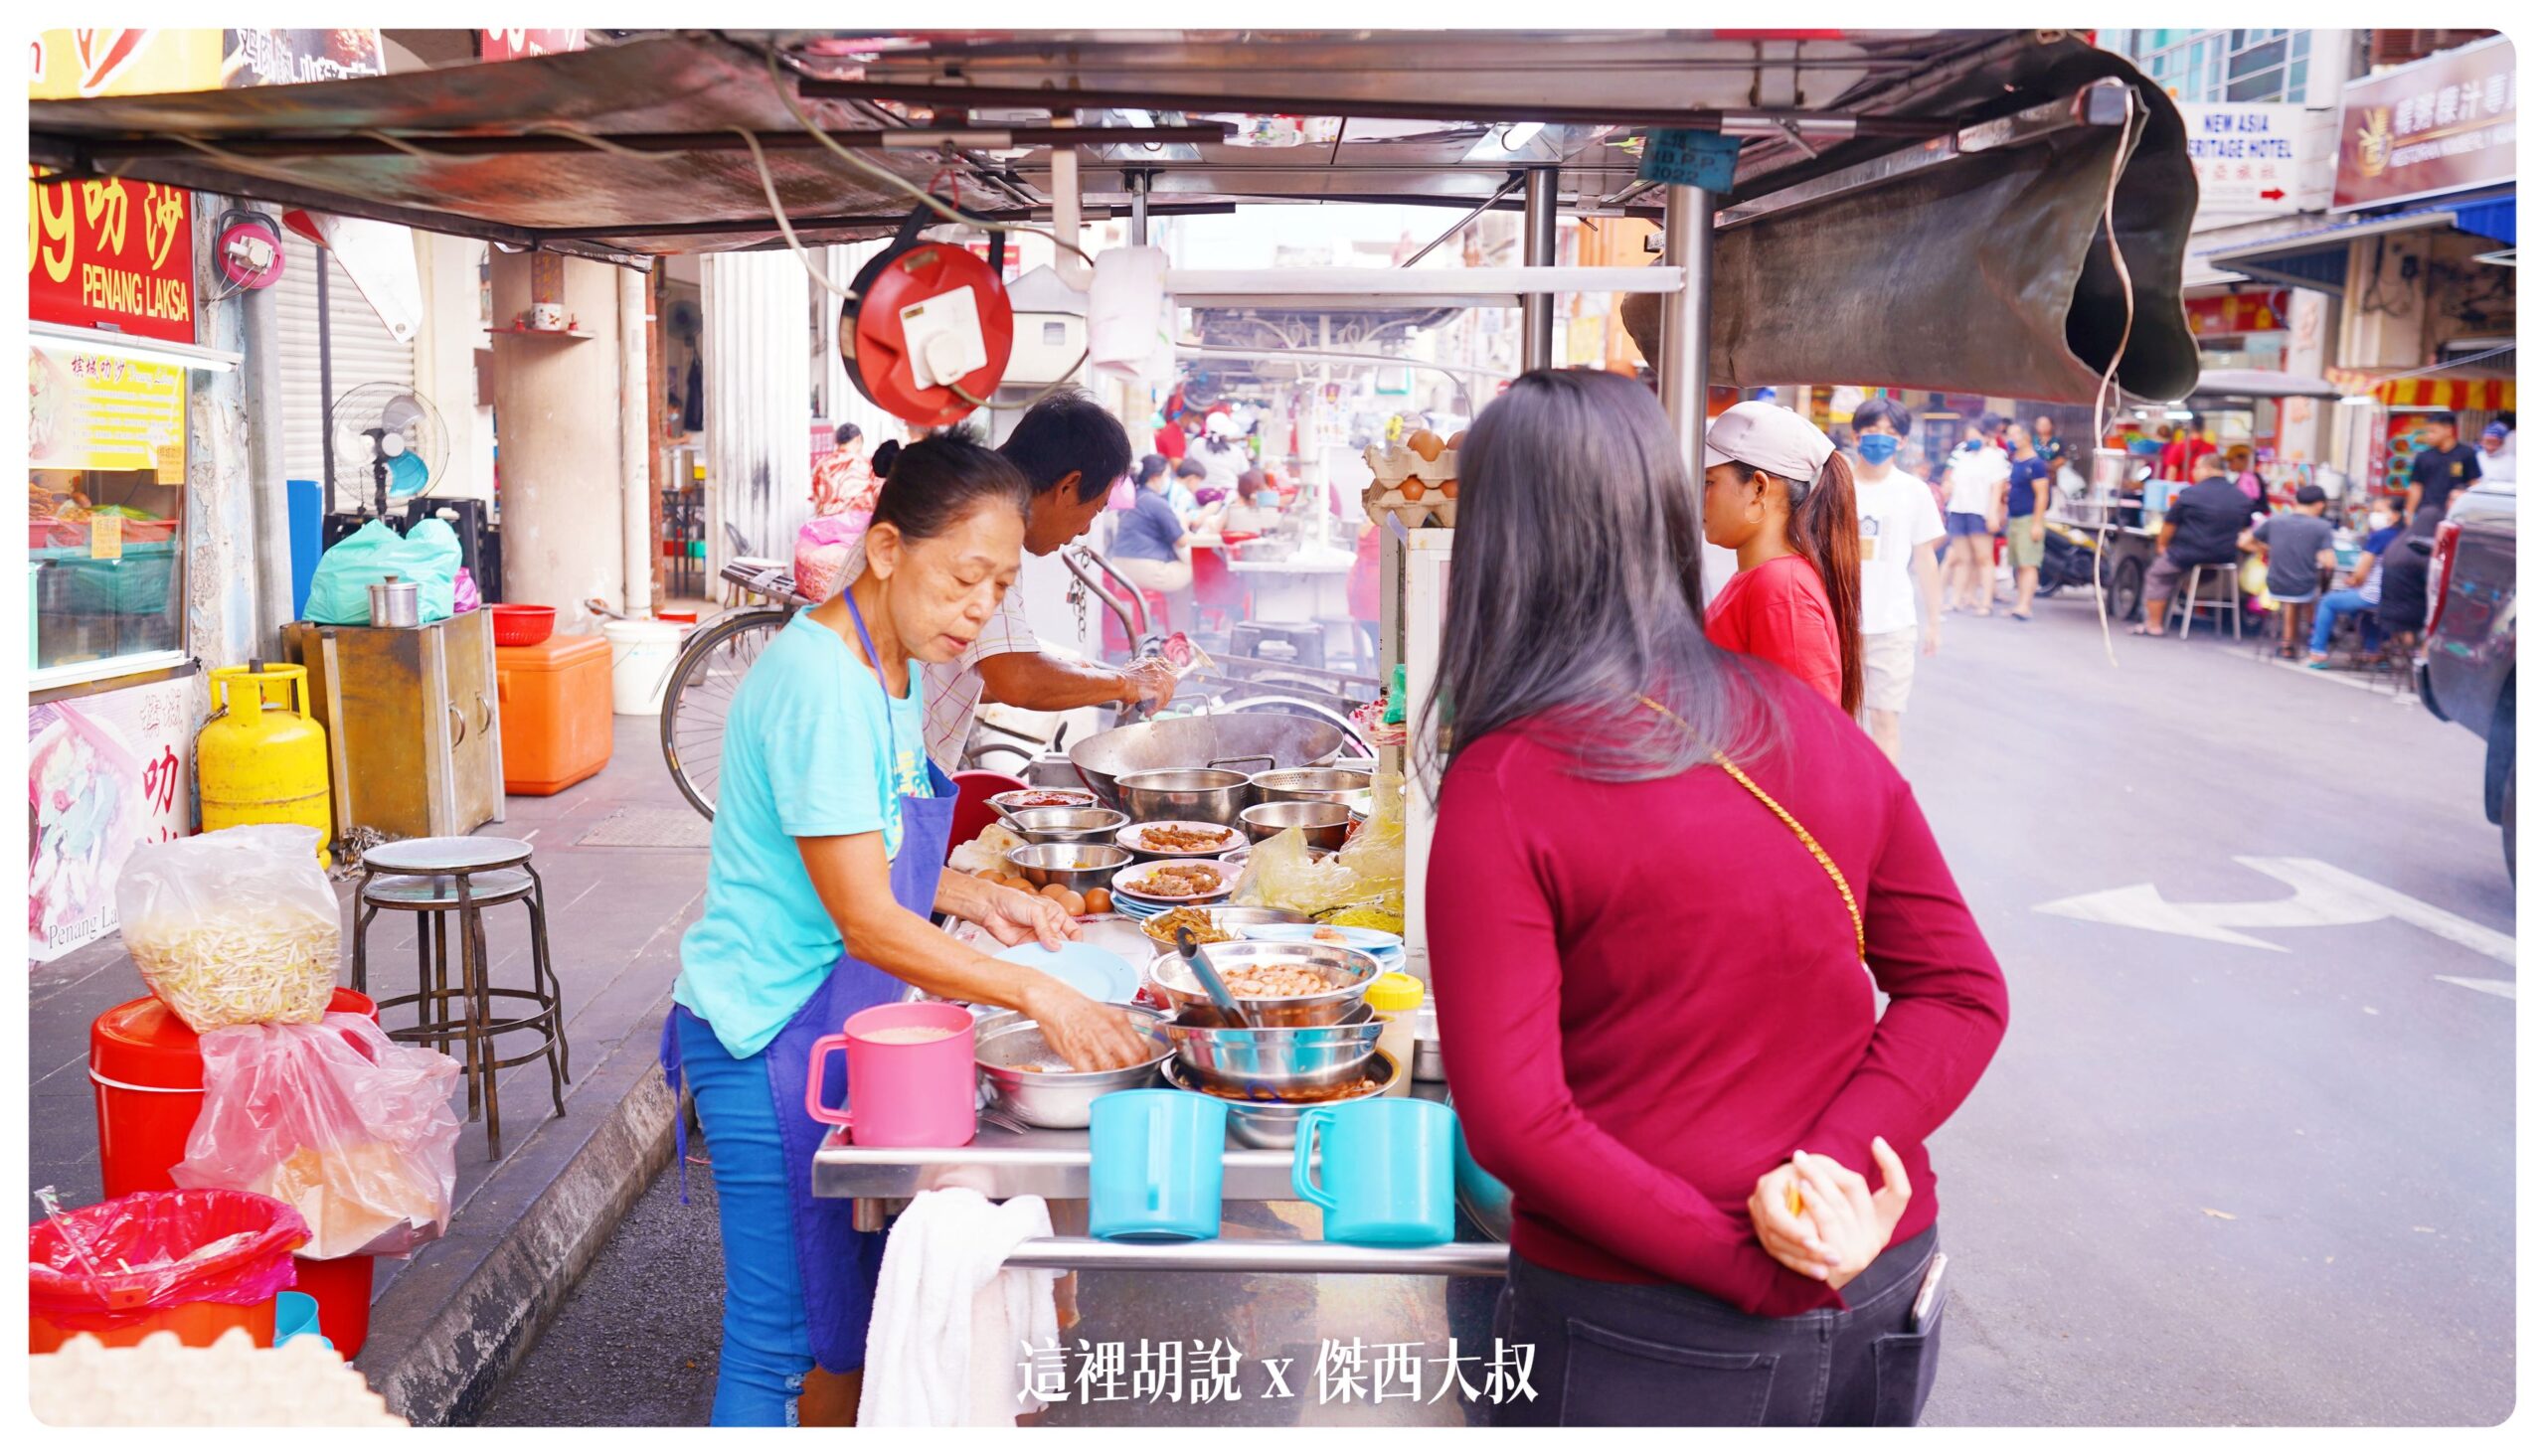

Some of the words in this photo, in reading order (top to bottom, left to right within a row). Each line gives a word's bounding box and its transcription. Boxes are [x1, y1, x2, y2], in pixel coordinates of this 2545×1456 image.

[2204, 114, 2233, 132] NEW
[2238, 114, 2269, 132] ASIA
[2188, 139, 2245, 158] ERITAGE
[2249, 139, 2292, 158] HOTEL
[83, 263, 143, 316] PENANG
[146, 275, 190, 322] LAKSA
[49, 916, 97, 950] Penang
